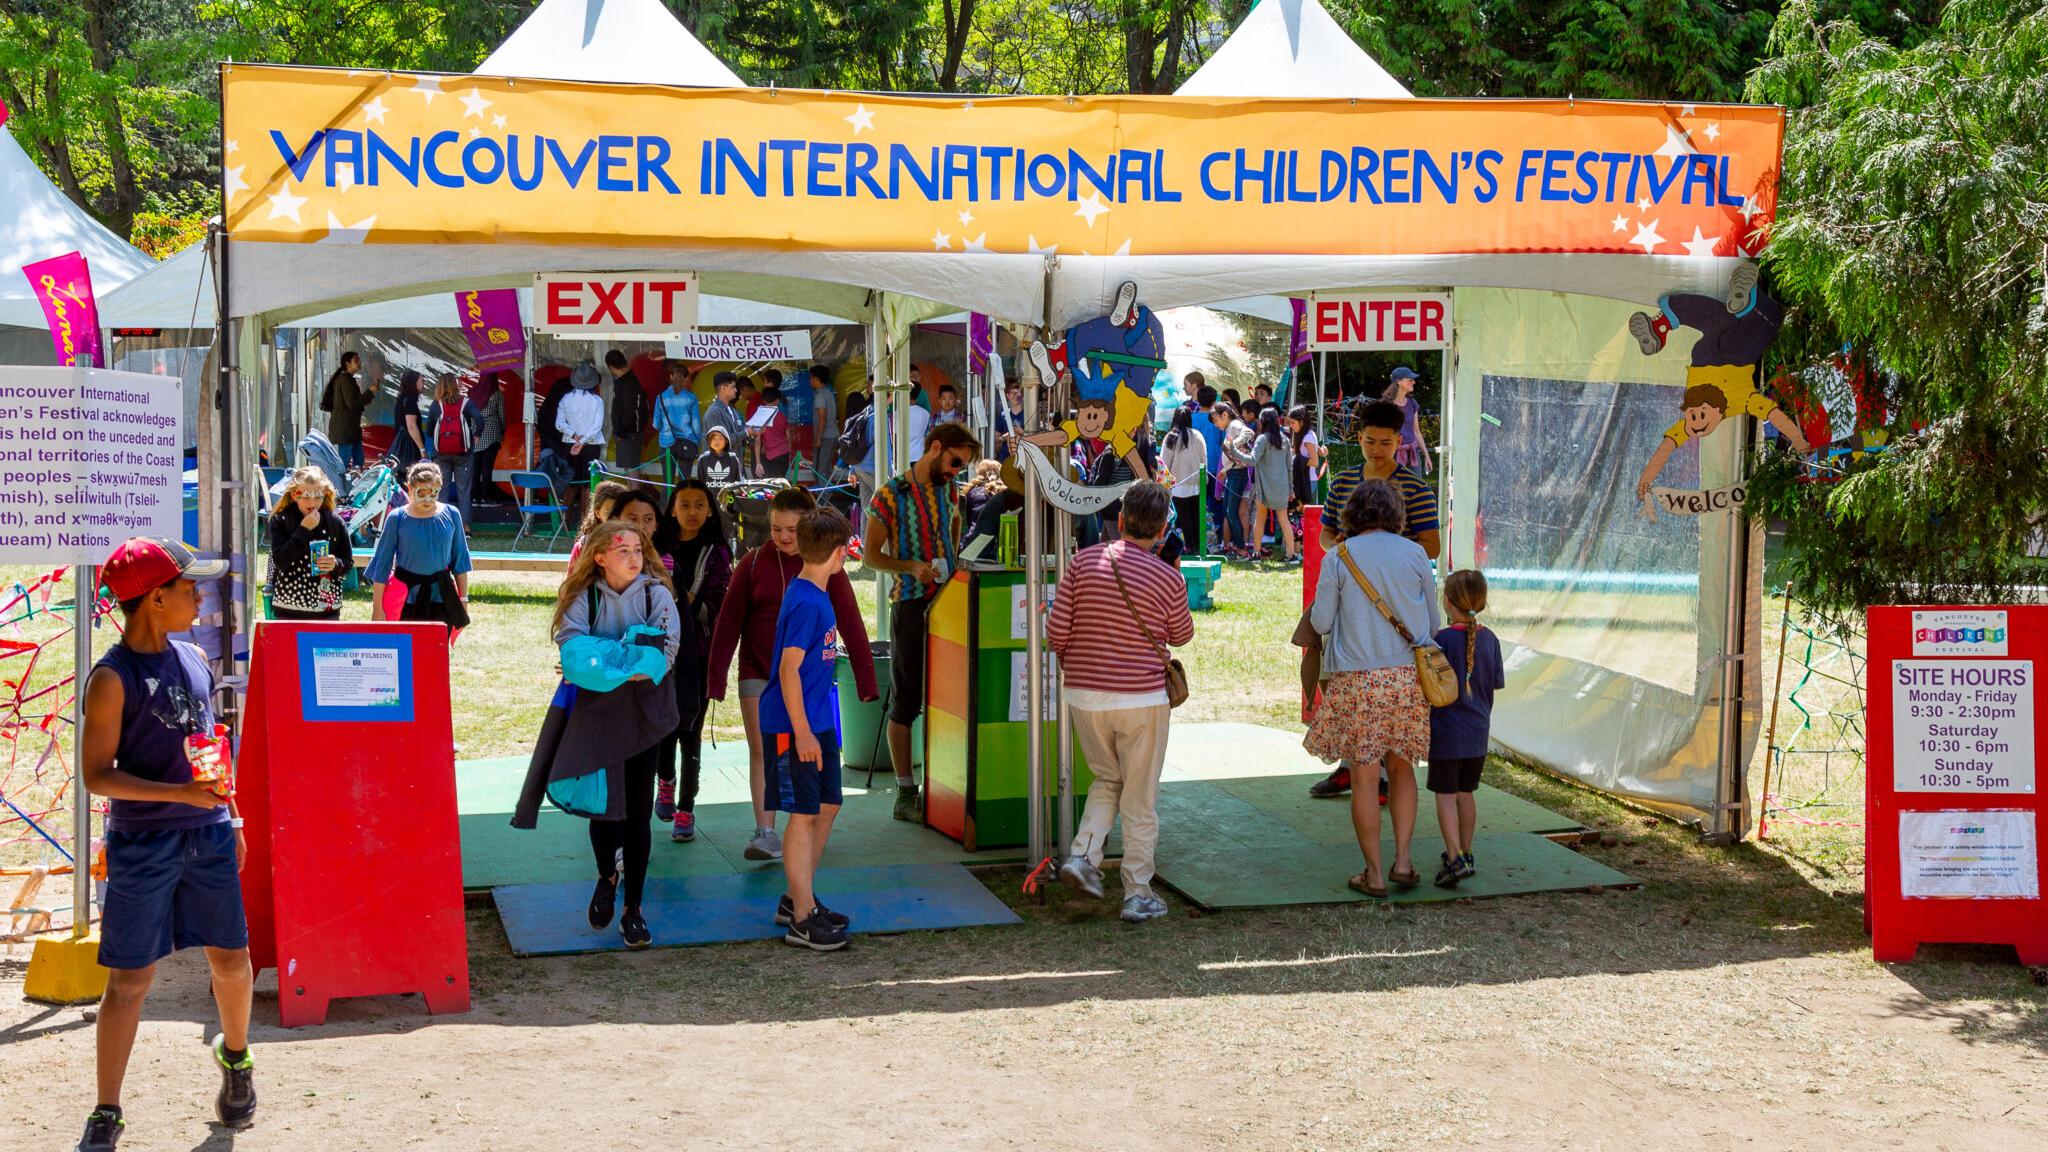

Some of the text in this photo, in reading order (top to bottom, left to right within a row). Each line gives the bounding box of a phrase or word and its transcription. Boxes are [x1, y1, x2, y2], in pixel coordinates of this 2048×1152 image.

[269, 128, 1746, 208] VANCOUVER INTERNATIONAL CHILDREN'S FESTIVAL
[547, 281, 687, 325] EXIT
[1316, 300, 1445, 343] ENTER
[690, 334, 784, 347] LUNARFEST
[684, 346, 794, 359] MOON CRAWL
[80, 385, 150, 404] International
[39, 406, 100, 421] Festival
[103, 409, 176, 429] acknowledges
[0, 427, 175, 447] is held on the unceded and
[38, 448, 110, 463] territories
[113, 450, 124, 464] of
[127, 451, 143, 465] the
[146, 453, 175, 467] Coast
[4, 469, 72, 485] peoples
[125, 491, 160, 508] (Tsleil-
[34, 512, 66, 525] and
[58, 533, 110, 547] Nations
[361, 652, 393, 660] FILMING
[1899, 668, 2026, 686] SITE HOURS
[1909, 690, 1962, 704] Monday
[1975, 690, 2017, 705] Friday
[1911, 705, 1943, 718] 9:30
[1958, 705, 2016, 721] 2:30pm
[1928, 724, 1999, 739] Saturday
[1919, 740, 1960, 752] 10:30
[1975, 740, 2009, 755] 6pm
[1934, 758, 1994, 773] Sunday
[1919, 775, 1961, 787] 10:30
[1976, 775, 2009, 789] 5pm
